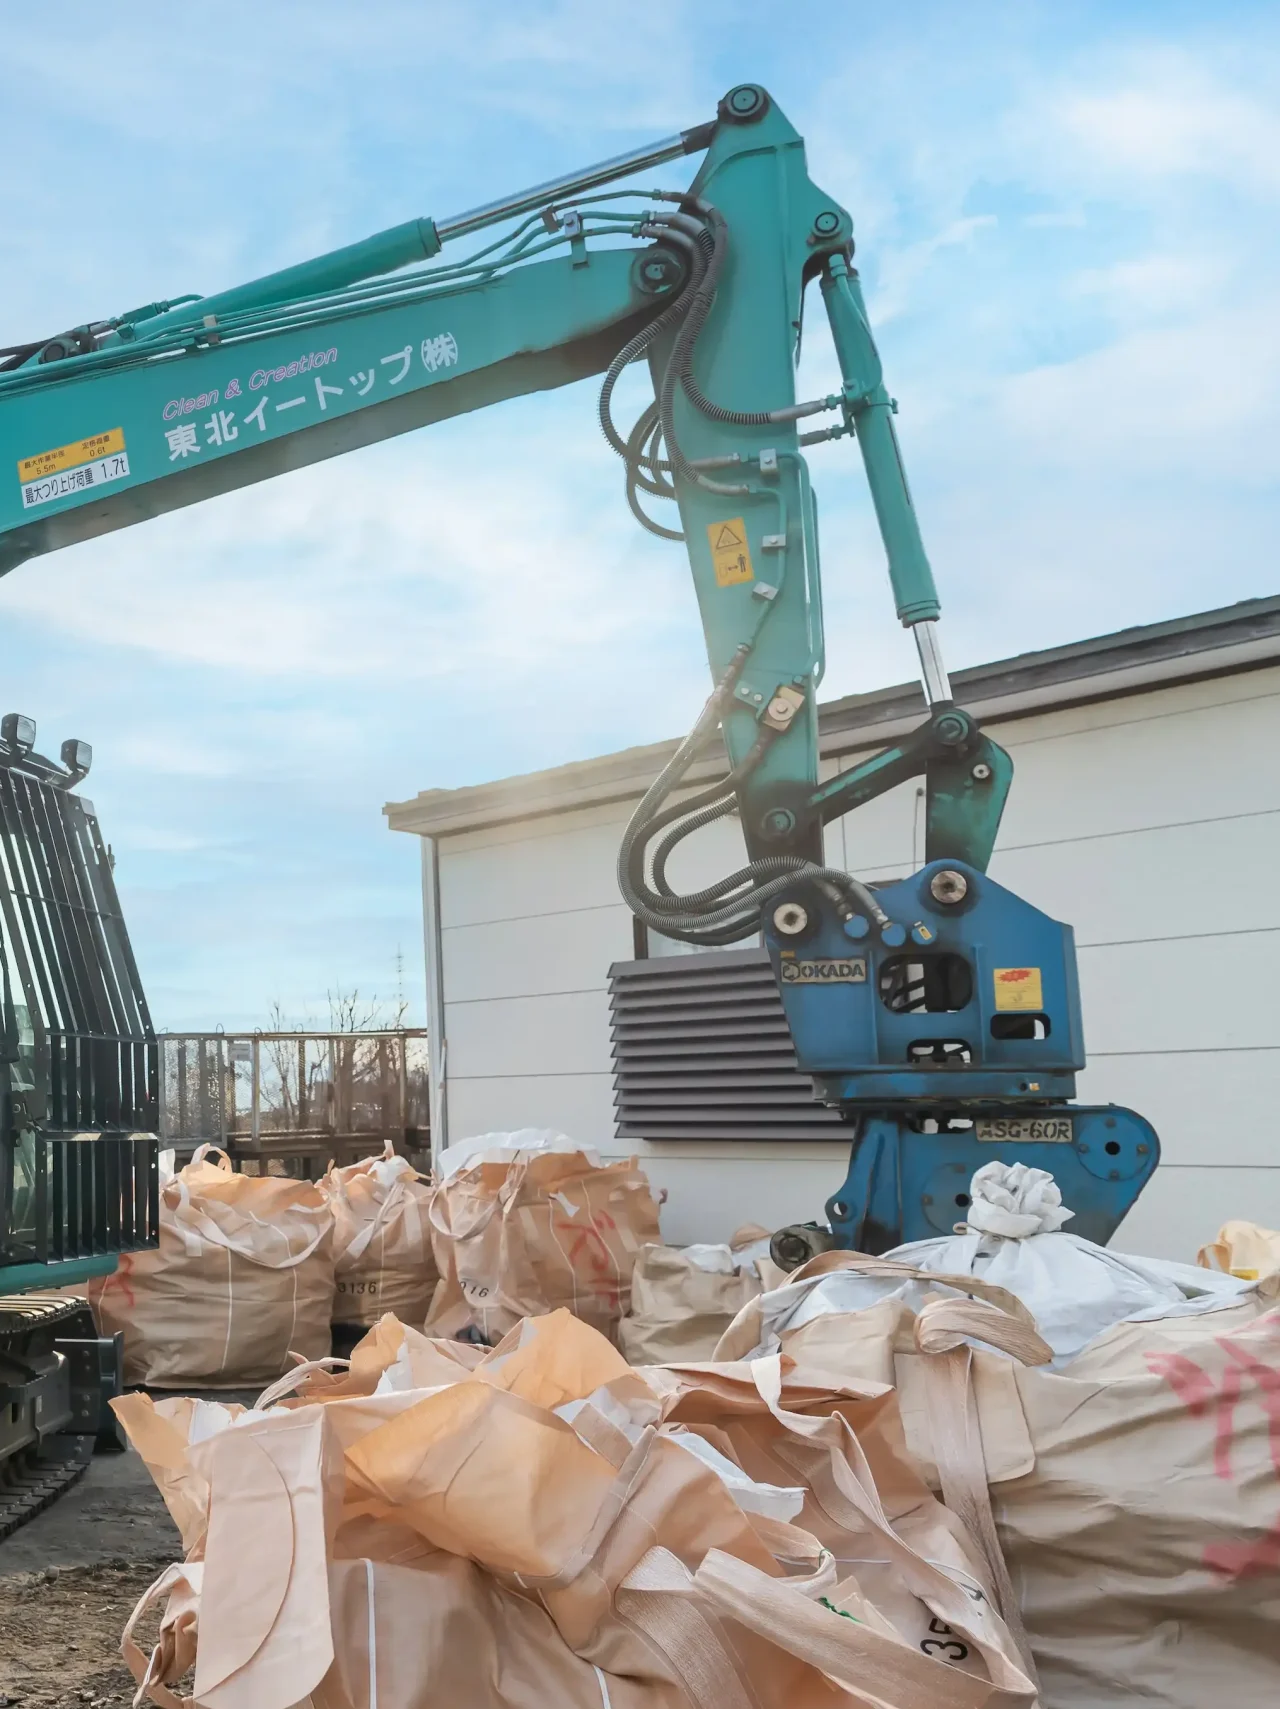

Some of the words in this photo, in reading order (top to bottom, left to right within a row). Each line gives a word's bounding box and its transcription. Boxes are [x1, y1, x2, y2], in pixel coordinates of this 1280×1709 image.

[163, 389, 219, 421] Clean
[225, 378, 243, 400] &
[249, 347, 338, 391] Creation
[89, 446, 106, 458] 0.6t
[36, 464, 56, 475] 5.5m
[25, 468, 94, 503] 最大つり上げ荷重
[101, 457, 126, 479] 1.7t
[801, 963, 865, 979] OKADA
